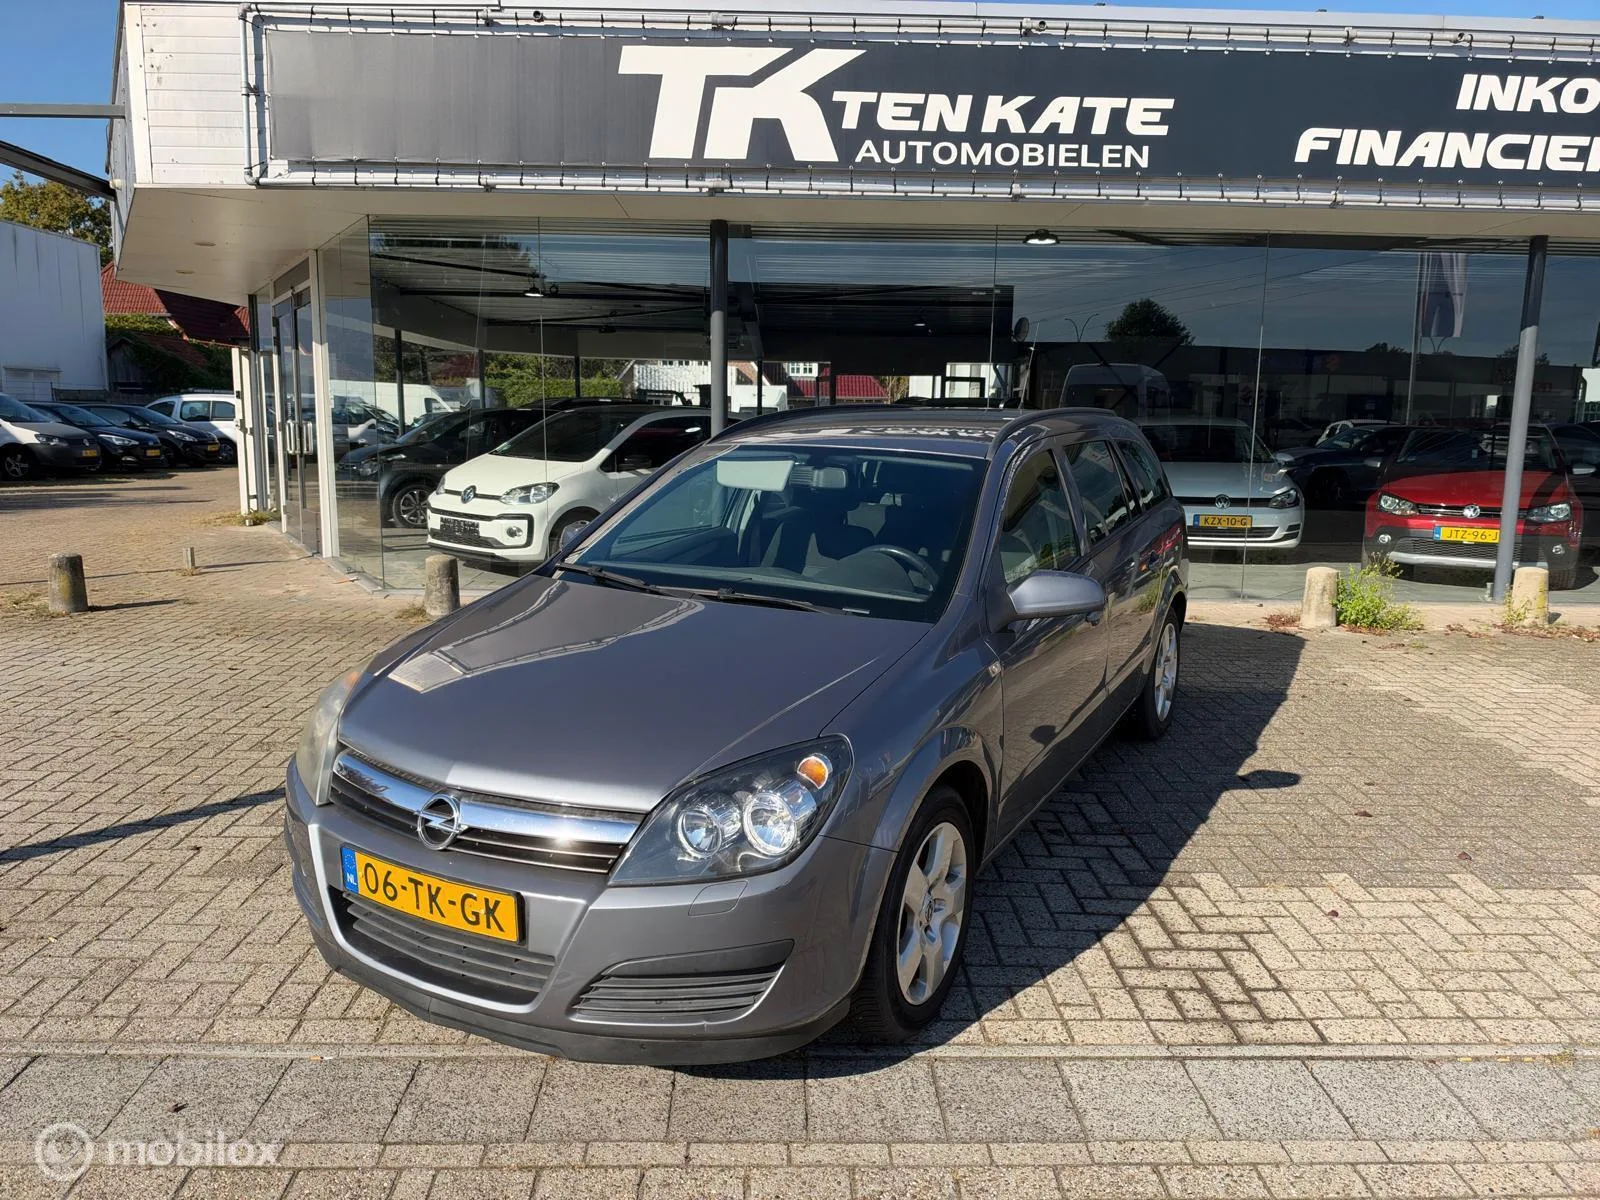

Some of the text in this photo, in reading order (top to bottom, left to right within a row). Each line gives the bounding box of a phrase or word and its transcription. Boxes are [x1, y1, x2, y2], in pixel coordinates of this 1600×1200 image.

[618, 45, 866, 161] TK
[1456, 74, 1600, 113] INKO
[832, 91, 1175, 135] TEN KATE
[854, 139, 1149, 168] AUTOMOBIELEN
[1203, 517, 1247, 526] KZX-10-G
[1446, 529, 1498, 541] JTZ-96-J
[346, 872, 357, 886] NL
[364, 862, 505, 932] 06-TK-GK
